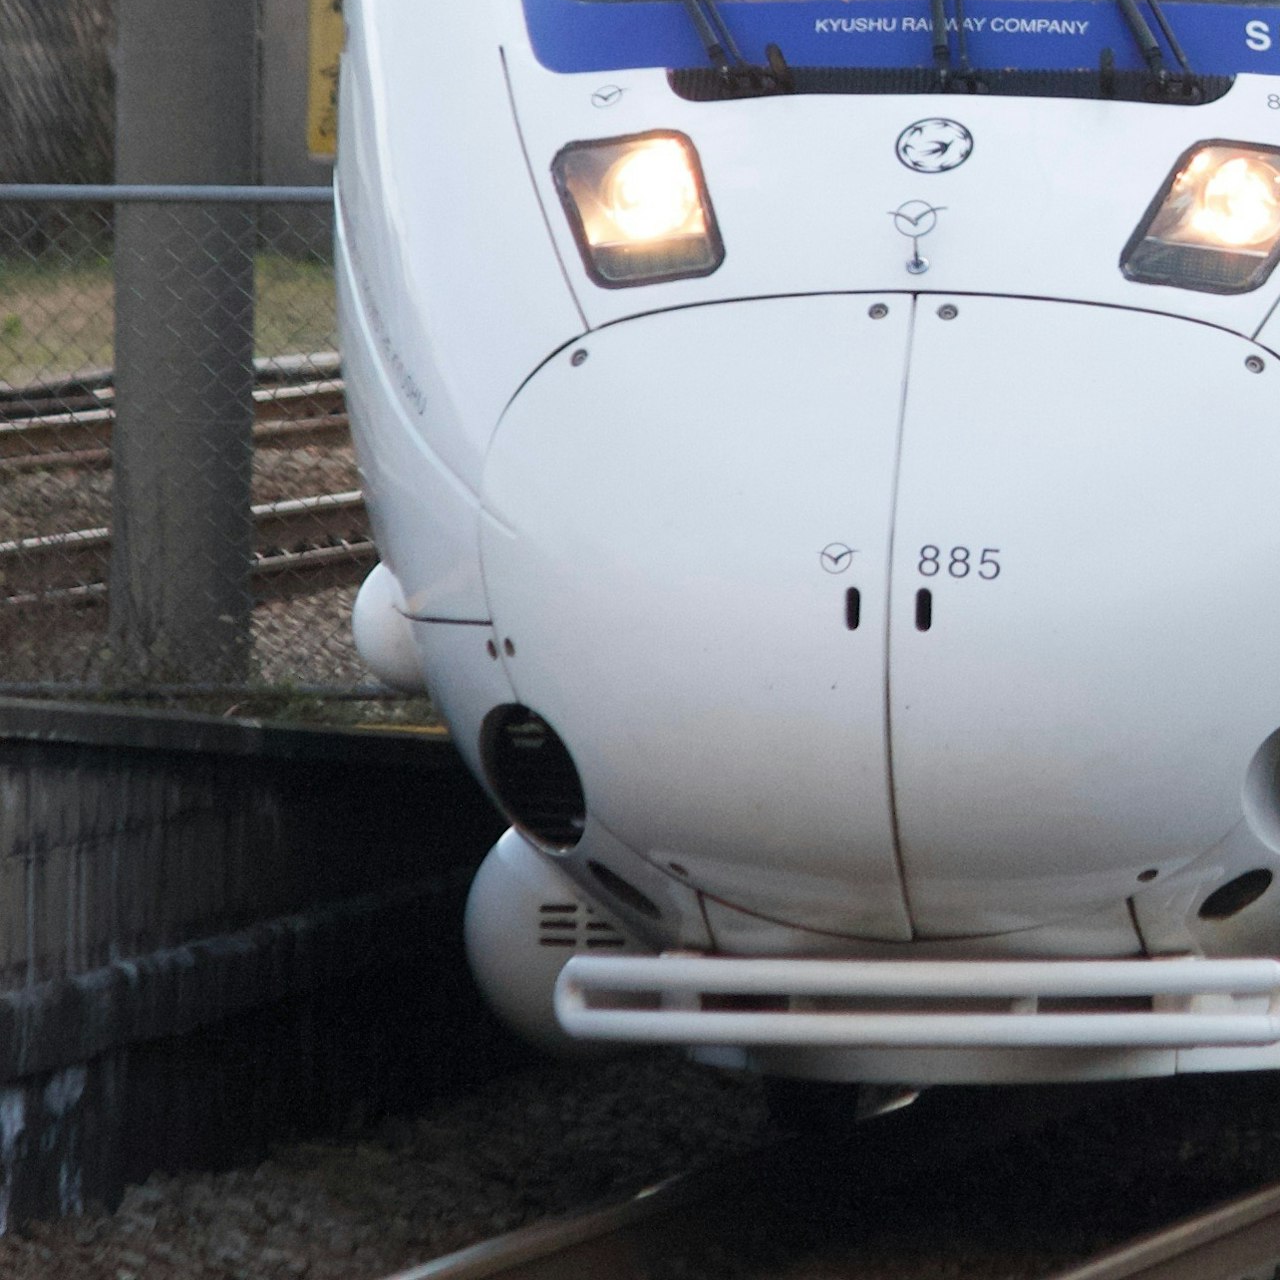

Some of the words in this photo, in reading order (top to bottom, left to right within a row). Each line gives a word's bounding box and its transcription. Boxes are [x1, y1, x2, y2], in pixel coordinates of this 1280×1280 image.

[815, 17, 896, 33] KYUSHU
[902, 16, 988, 32] RAIWAY
[990, 17, 1089, 35] COMPANY
[917, 544, 1001, 580] 885
